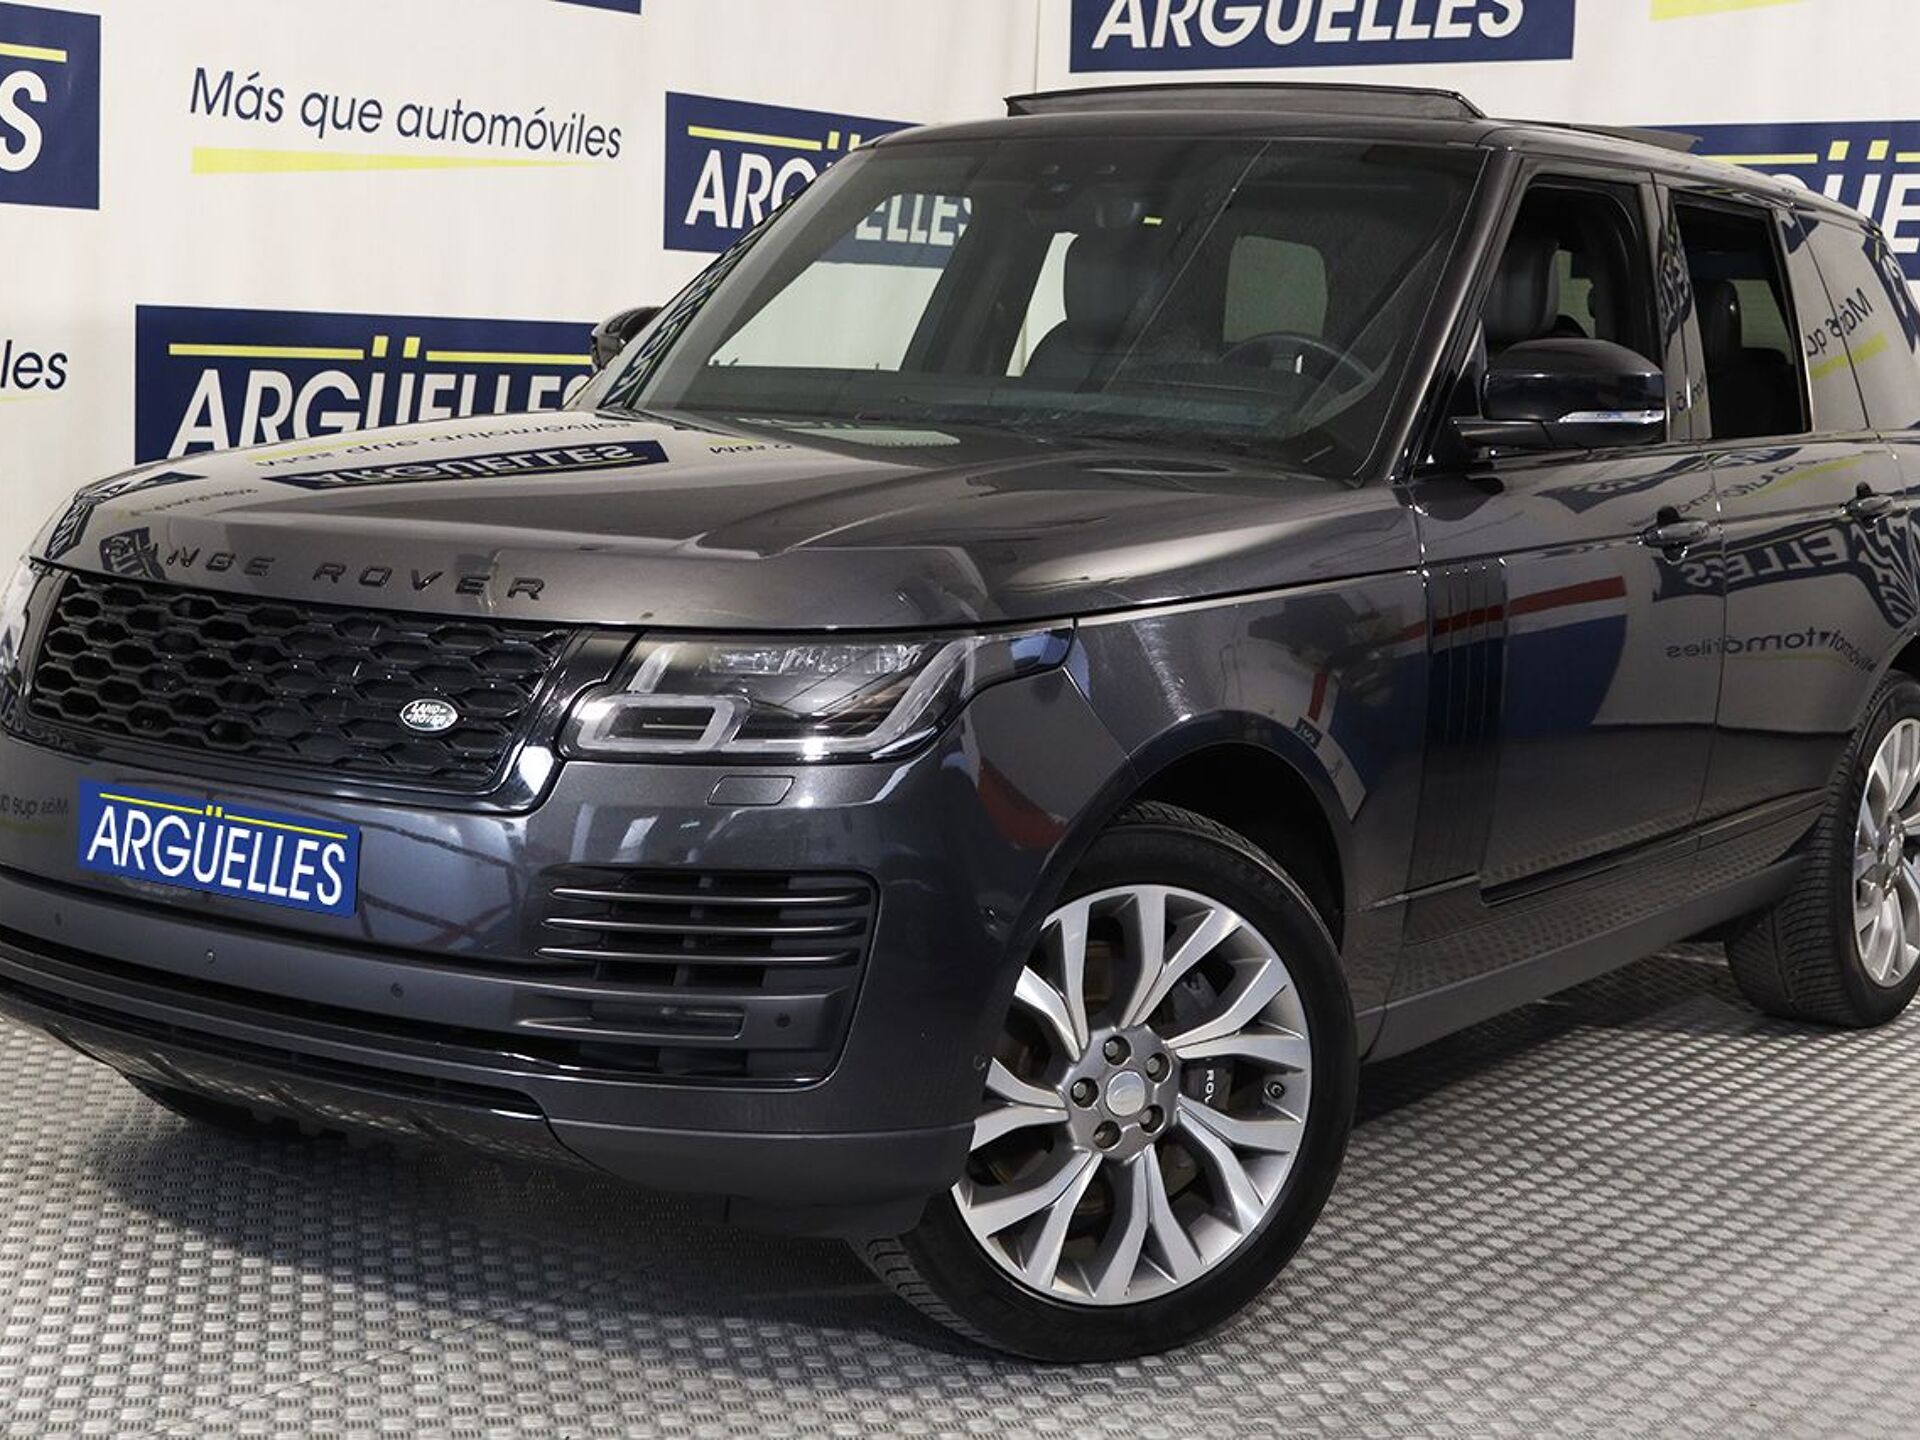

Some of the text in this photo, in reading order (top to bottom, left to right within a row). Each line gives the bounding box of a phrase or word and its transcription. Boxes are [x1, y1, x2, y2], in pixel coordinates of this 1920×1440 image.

[190, 67, 622, 159] Más que automóviles
[0, 339, 68, 390] les
[312, 562, 545, 600] ROVER
[87, 805, 346, 906] ARGÜELLES
